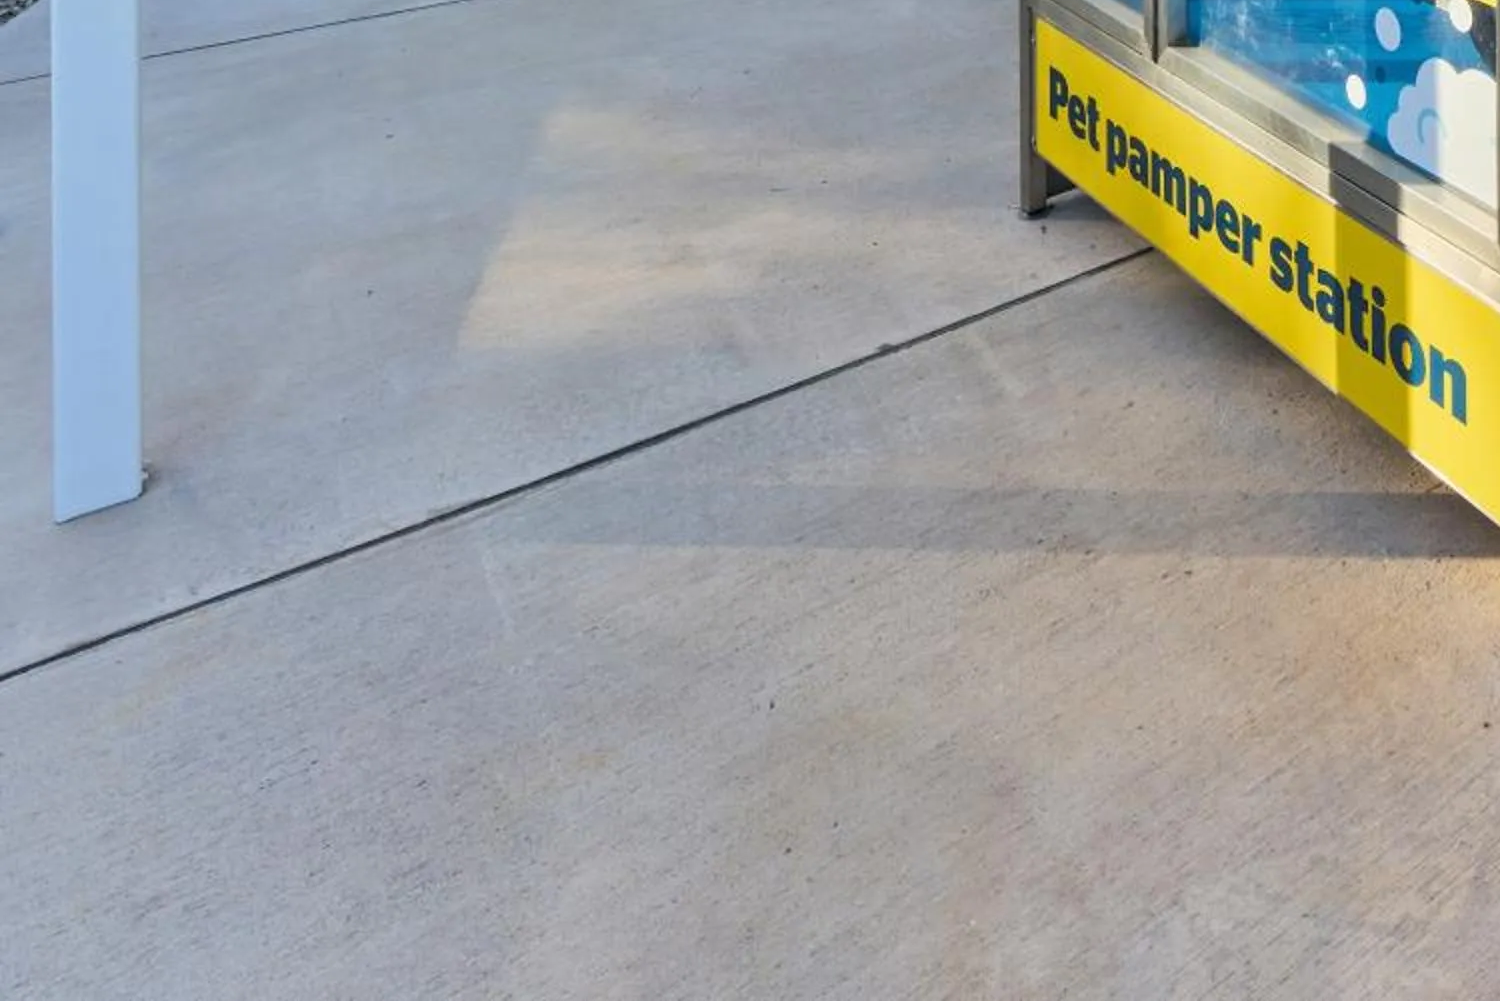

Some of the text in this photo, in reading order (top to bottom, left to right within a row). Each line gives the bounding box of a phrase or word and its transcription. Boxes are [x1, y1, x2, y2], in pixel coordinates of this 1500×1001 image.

[1049, 65, 1467, 426] Pet pamper station
